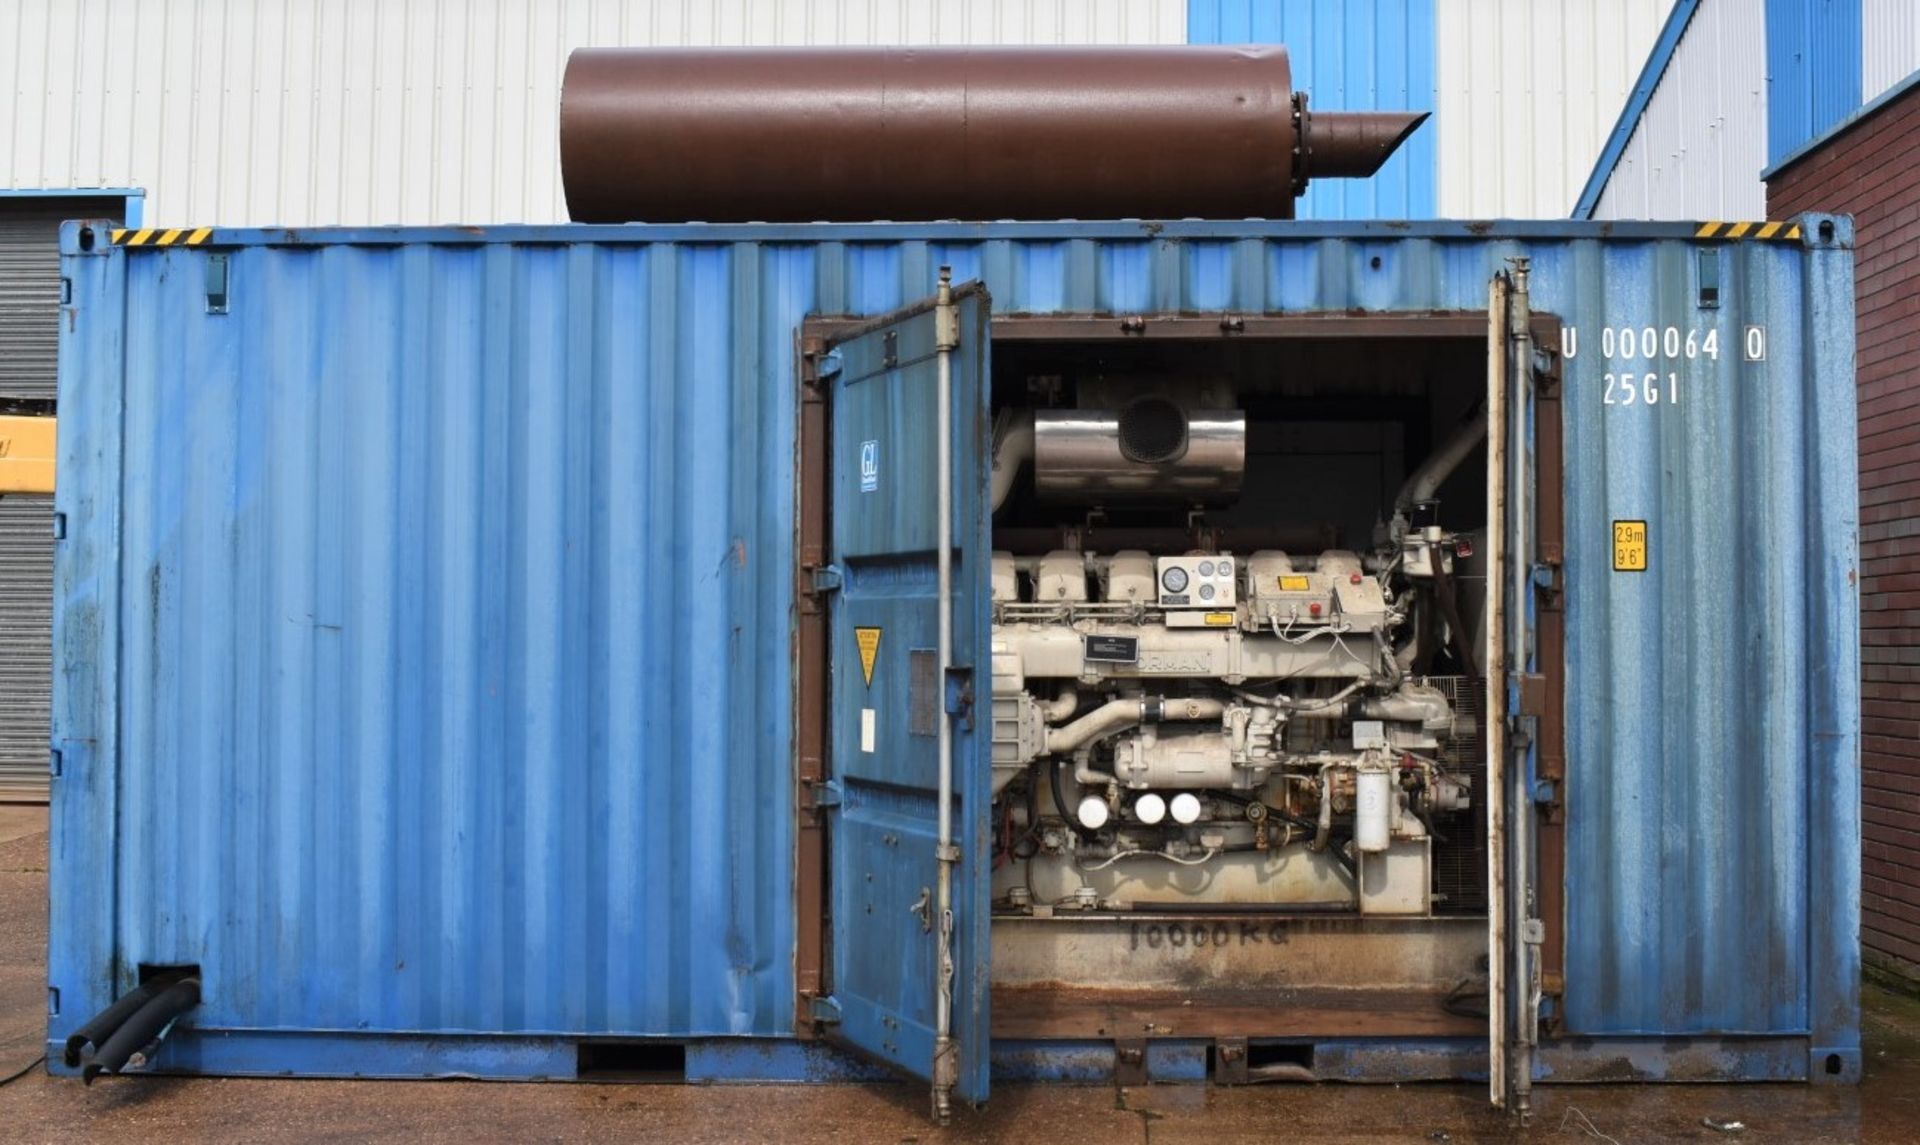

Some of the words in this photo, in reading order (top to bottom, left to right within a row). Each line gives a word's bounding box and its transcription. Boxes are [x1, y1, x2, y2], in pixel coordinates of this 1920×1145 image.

[1602, 327, 1718, 359] 000064
[1747, 328, 1762, 359] 0
[1604, 373, 1677, 404] 25G1
